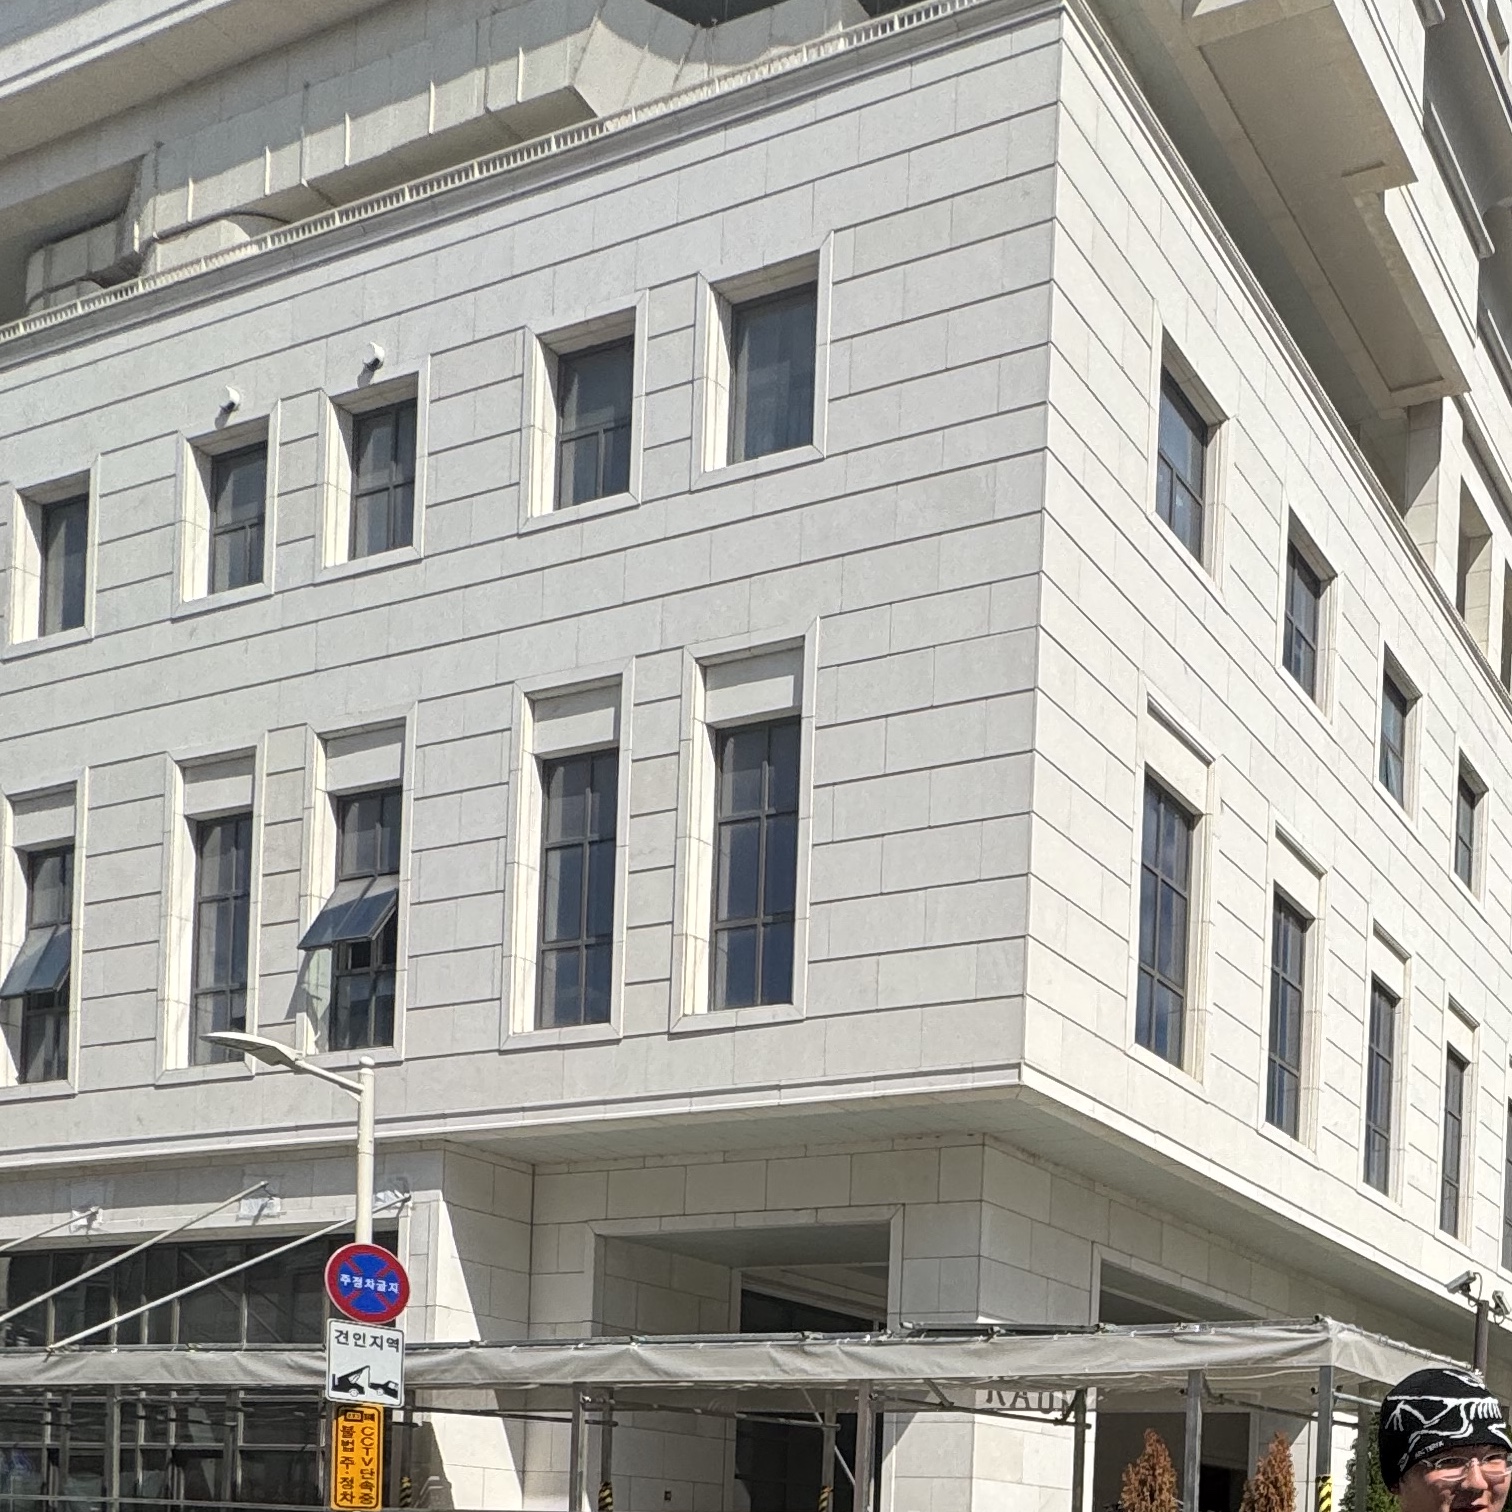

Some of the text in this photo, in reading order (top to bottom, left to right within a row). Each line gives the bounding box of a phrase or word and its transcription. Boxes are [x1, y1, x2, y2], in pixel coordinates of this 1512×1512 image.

[339, 1273, 399, 1294] 주정차금지
[334, 1329, 400, 1352] 견인지역
[340, 1424, 356, 1453] 불법
